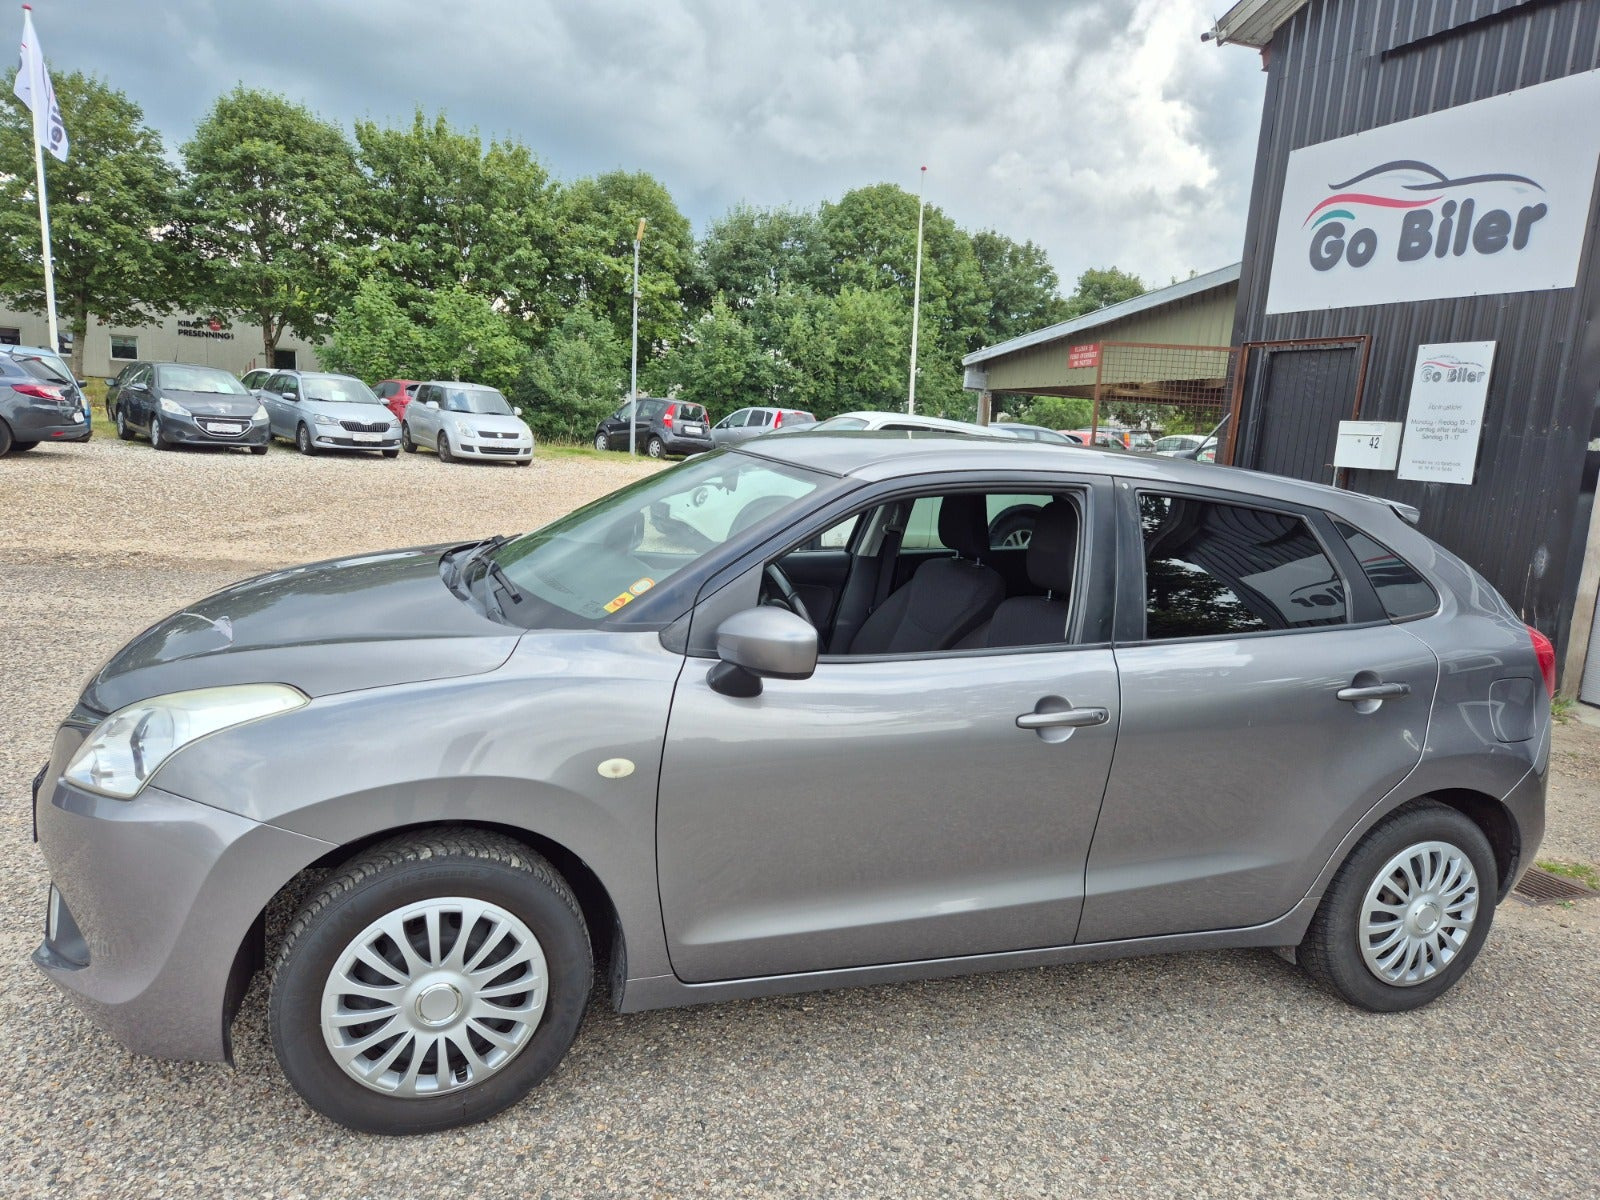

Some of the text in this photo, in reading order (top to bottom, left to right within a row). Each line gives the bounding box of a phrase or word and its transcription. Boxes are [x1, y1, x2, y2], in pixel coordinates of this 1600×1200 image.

[1309, 198, 1547, 272] Go Biler
[177, 328, 231, 340] PRESENNING
[1421, 367, 1486, 383] Go Biler
[1369, 436, 1380, 449] 42
